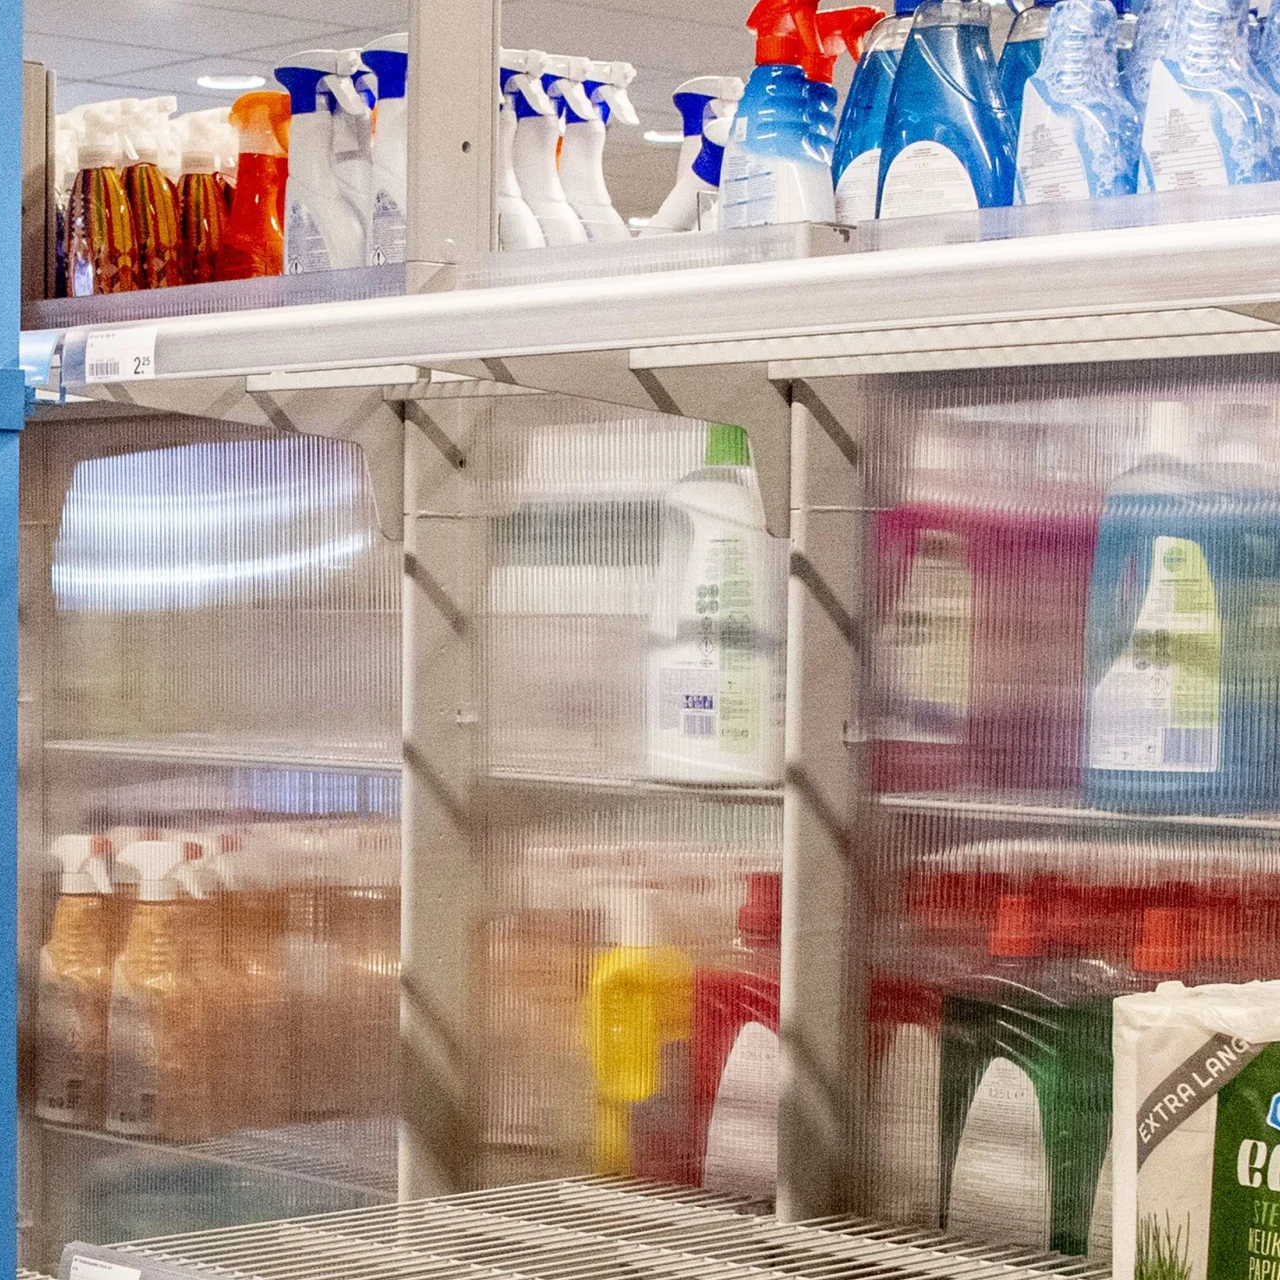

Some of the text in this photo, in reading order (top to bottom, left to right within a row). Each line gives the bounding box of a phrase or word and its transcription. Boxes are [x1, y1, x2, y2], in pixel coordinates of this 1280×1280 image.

[133, 356, 151, 375] 2.25
[1138, 1036, 1251, 1144] EXTRA LANG
